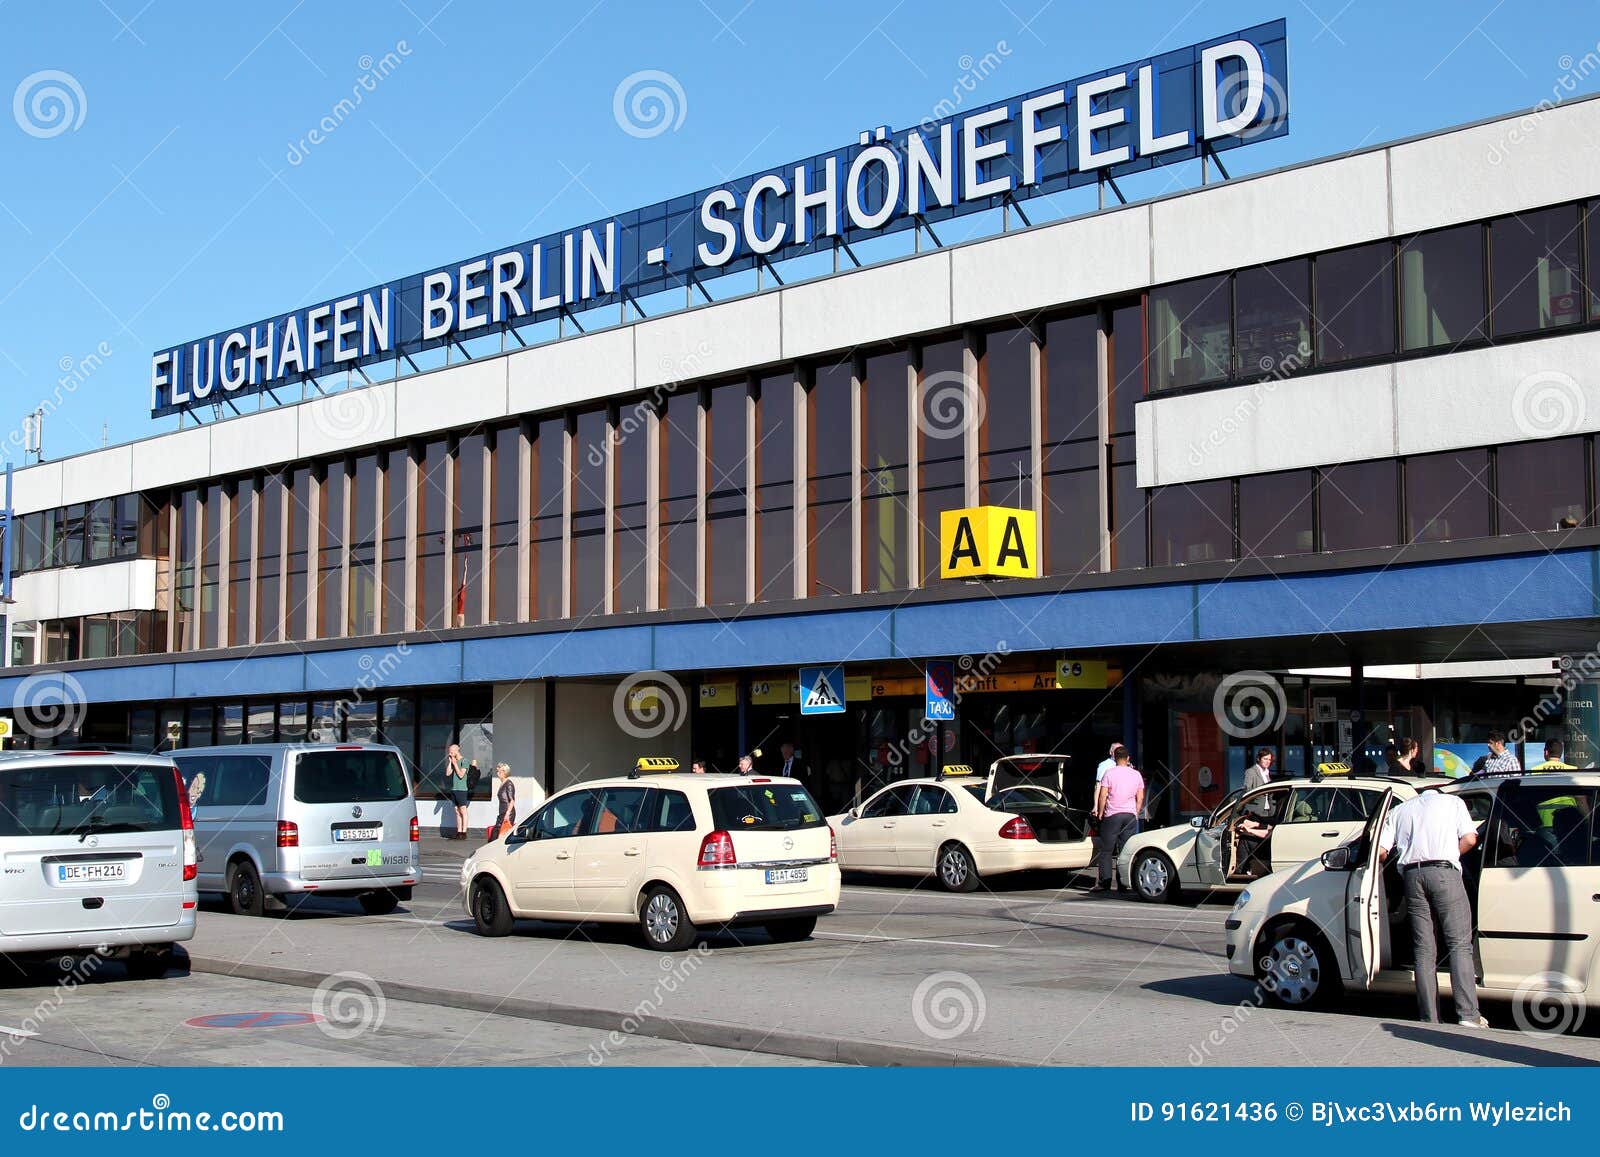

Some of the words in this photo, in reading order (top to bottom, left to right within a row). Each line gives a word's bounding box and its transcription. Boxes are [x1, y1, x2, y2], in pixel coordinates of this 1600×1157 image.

[151, 287, 393, 410] FLUGHAFEN
[423, 221, 620, 340] BERLIN
[697, 38, 1268, 267] SCHÖNEFELD
[948, 516, 981, 569] A
[996, 516, 1029, 569] A
[928, 701, 952, 714] TAXI
[103, 865, 123, 877] 216
